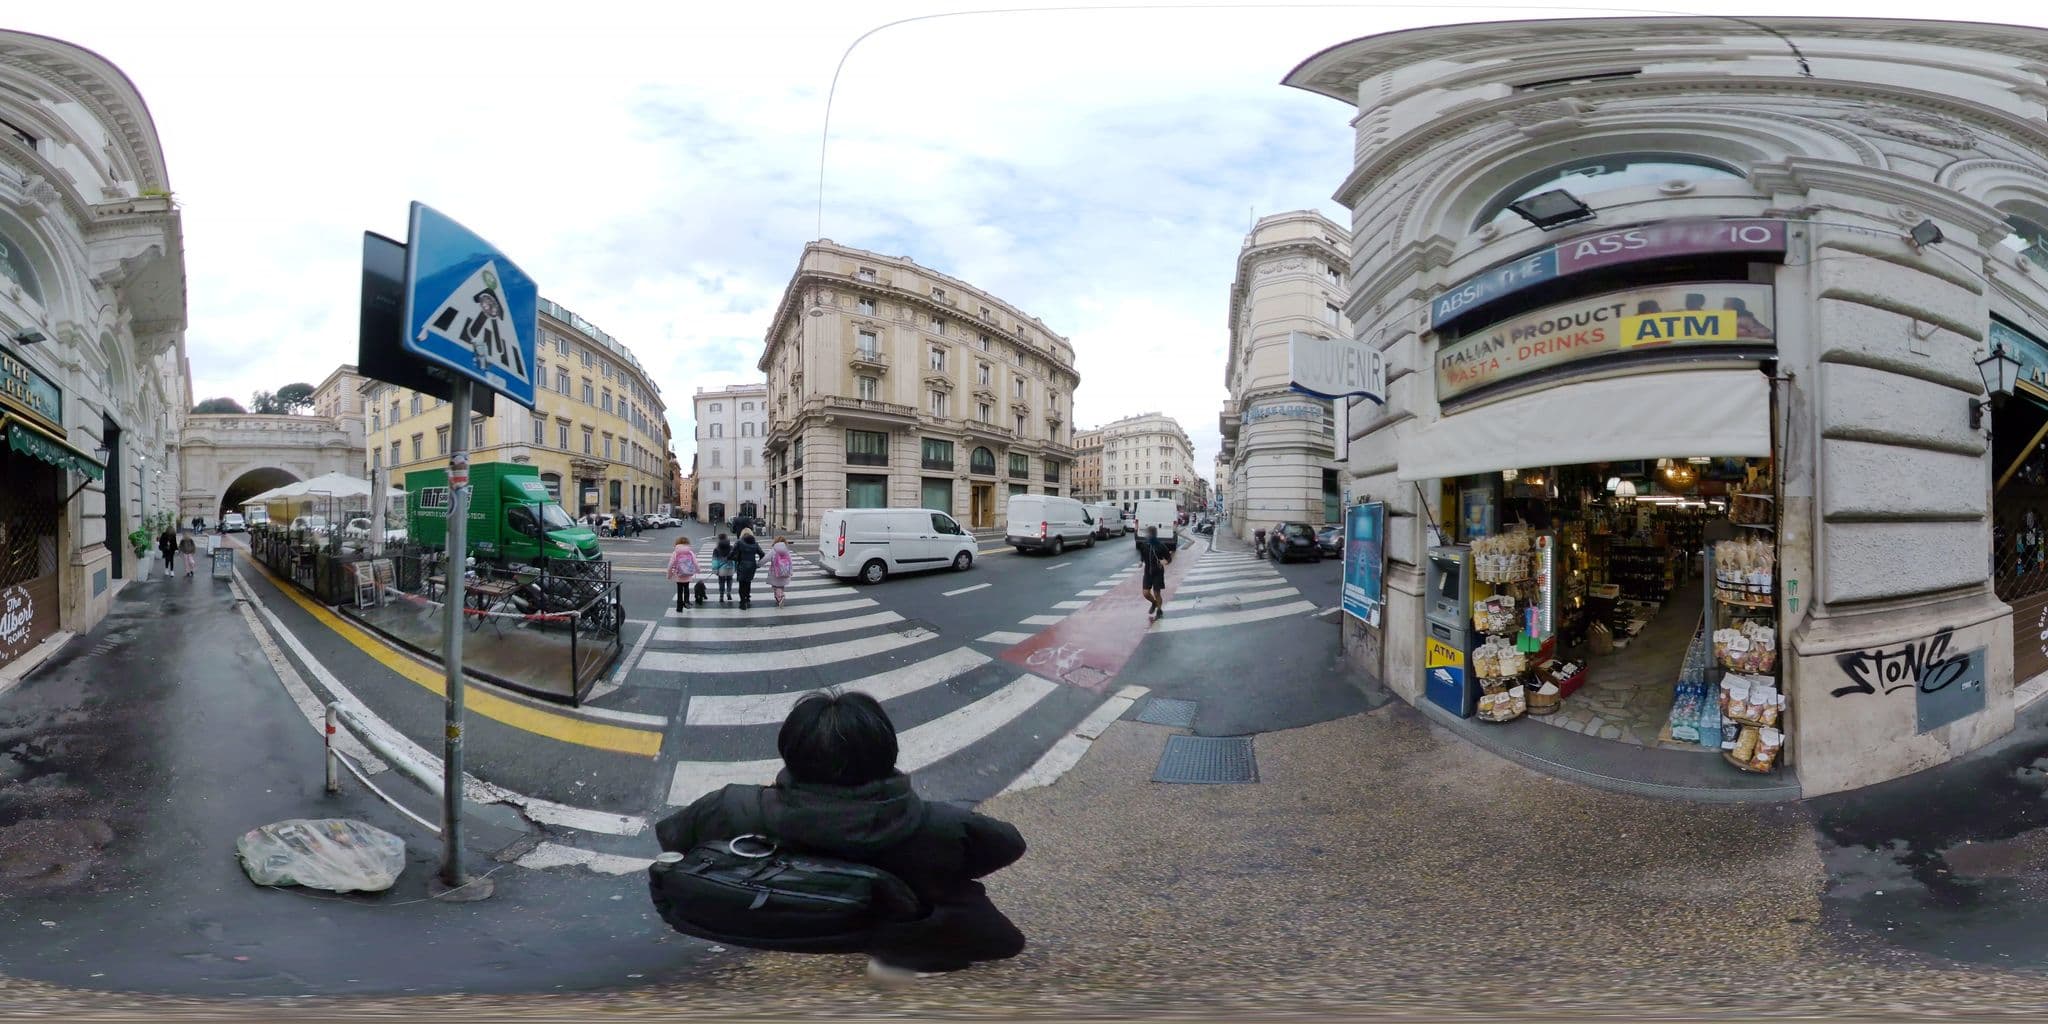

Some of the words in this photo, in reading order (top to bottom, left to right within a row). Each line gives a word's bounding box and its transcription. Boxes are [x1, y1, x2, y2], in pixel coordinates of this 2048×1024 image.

[1574, 225, 1771, 260] ASSIO
[1442, 334, 1505, 370] ITALIAN
[1511, 303, 1626, 344] PRODUCT
[1636, 315, 1719, 340] ATM
[3, 355, 29, 384] THE
[1446, 358, 1500, 384] PASTA
[1518, 327, 1606, 361] DRINKS
[1434, 643, 1456, 661] ATM
